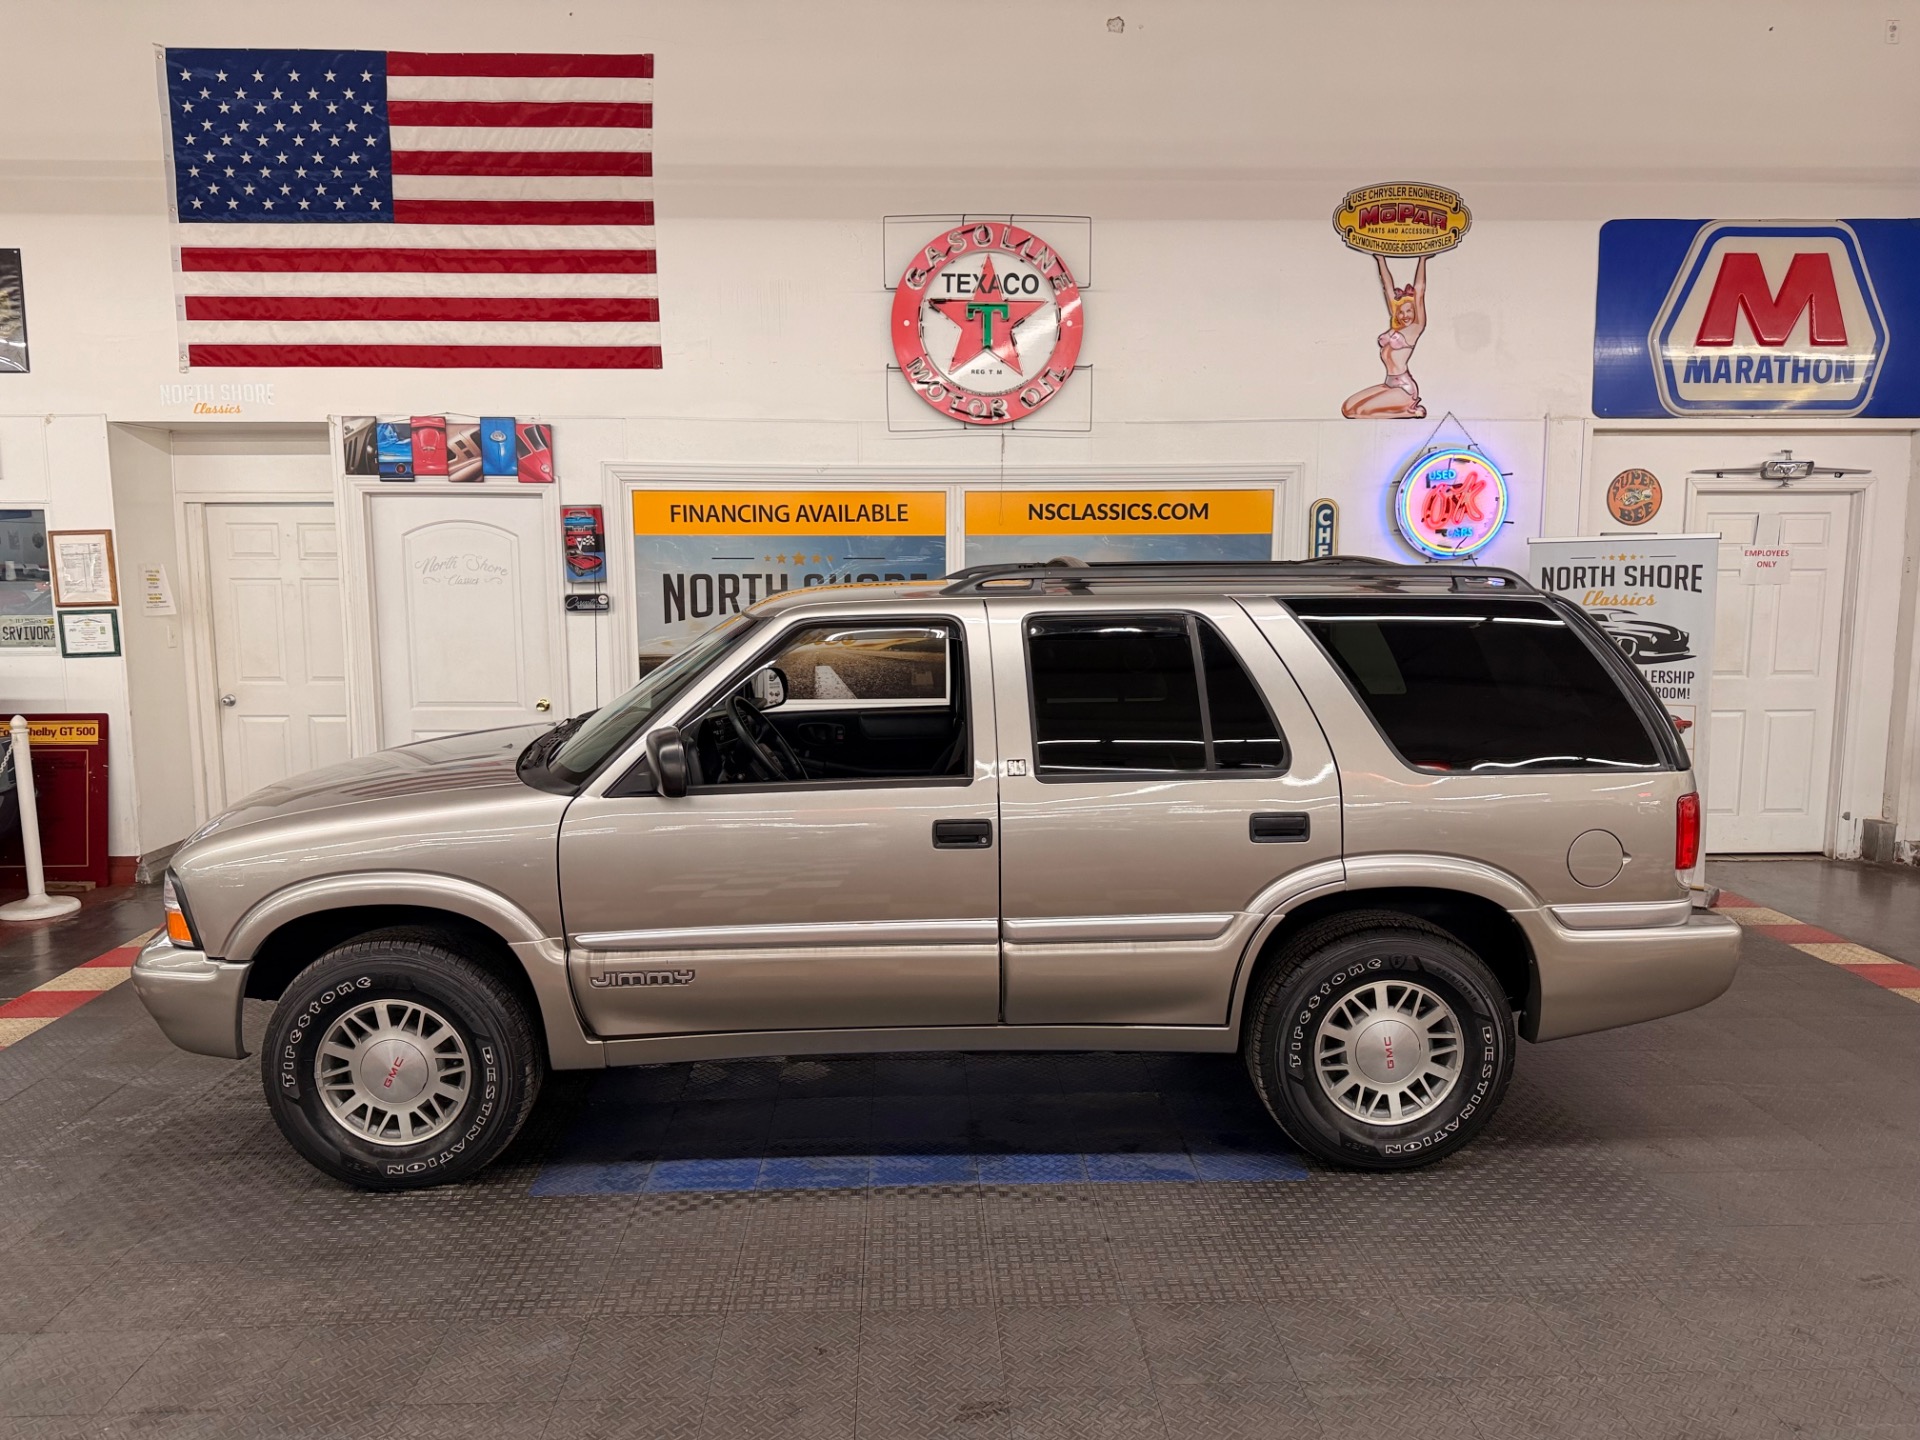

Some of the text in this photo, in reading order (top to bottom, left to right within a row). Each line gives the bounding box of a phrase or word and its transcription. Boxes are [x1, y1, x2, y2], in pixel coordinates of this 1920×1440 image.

[1352, 186, 1454, 205] USE CHRYSLER ENGINEERED
[1367, 227, 1439, 235] PARTS AND ACCESSORIES
[905, 223, 1074, 295] GASOLINE
[941, 272, 1040, 295] TEXACO
[1693, 252, 1849, 347] M
[966, 302, 1009, 350] T
[1682, 355, 1856, 385] MARATHON
[159, 383, 275, 407] NORTH SHORE
[906, 356, 1070, 422] MOTOR OIL
[193, 402, 242, 415] Classics
[1428, 469, 1456, 480] USED
[1612, 471, 1656, 502] SUPER
[669, 503, 909, 523] FINANCING AVAILABLE
[1028, 502, 1209, 521] NSCLASSICS.COM
[1619, 502, 1653, 523] BEE
[414, 553, 509, 576] North Shore
[1744, 549, 1790, 557] EMPLOYEES
[1756, 560, 1777, 568] ONLY
[1541, 564, 1704, 593] NORTH SHORE
[662, 573, 789, 624] NORTH
[1581, 590, 1657, 607] Classics
[1644, 670, 1695, 684] LERSHIP
[1655, 686, 1690, 700] ROOM!
[29, 727, 57, 738] helby
[59, 727, 75, 737] GT
[76, 727, 96, 737] 500
[1289, 958, 1383, 1068] Firestone
[282, 976, 372, 1088] Firestone
[1383, 1036, 1395, 1070] GMC
[383, 1056, 404, 1089] GMC
[1385, 1026, 1495, 1154] DESTINATION
[387, 1046, 497, 1176] DESTINATION
